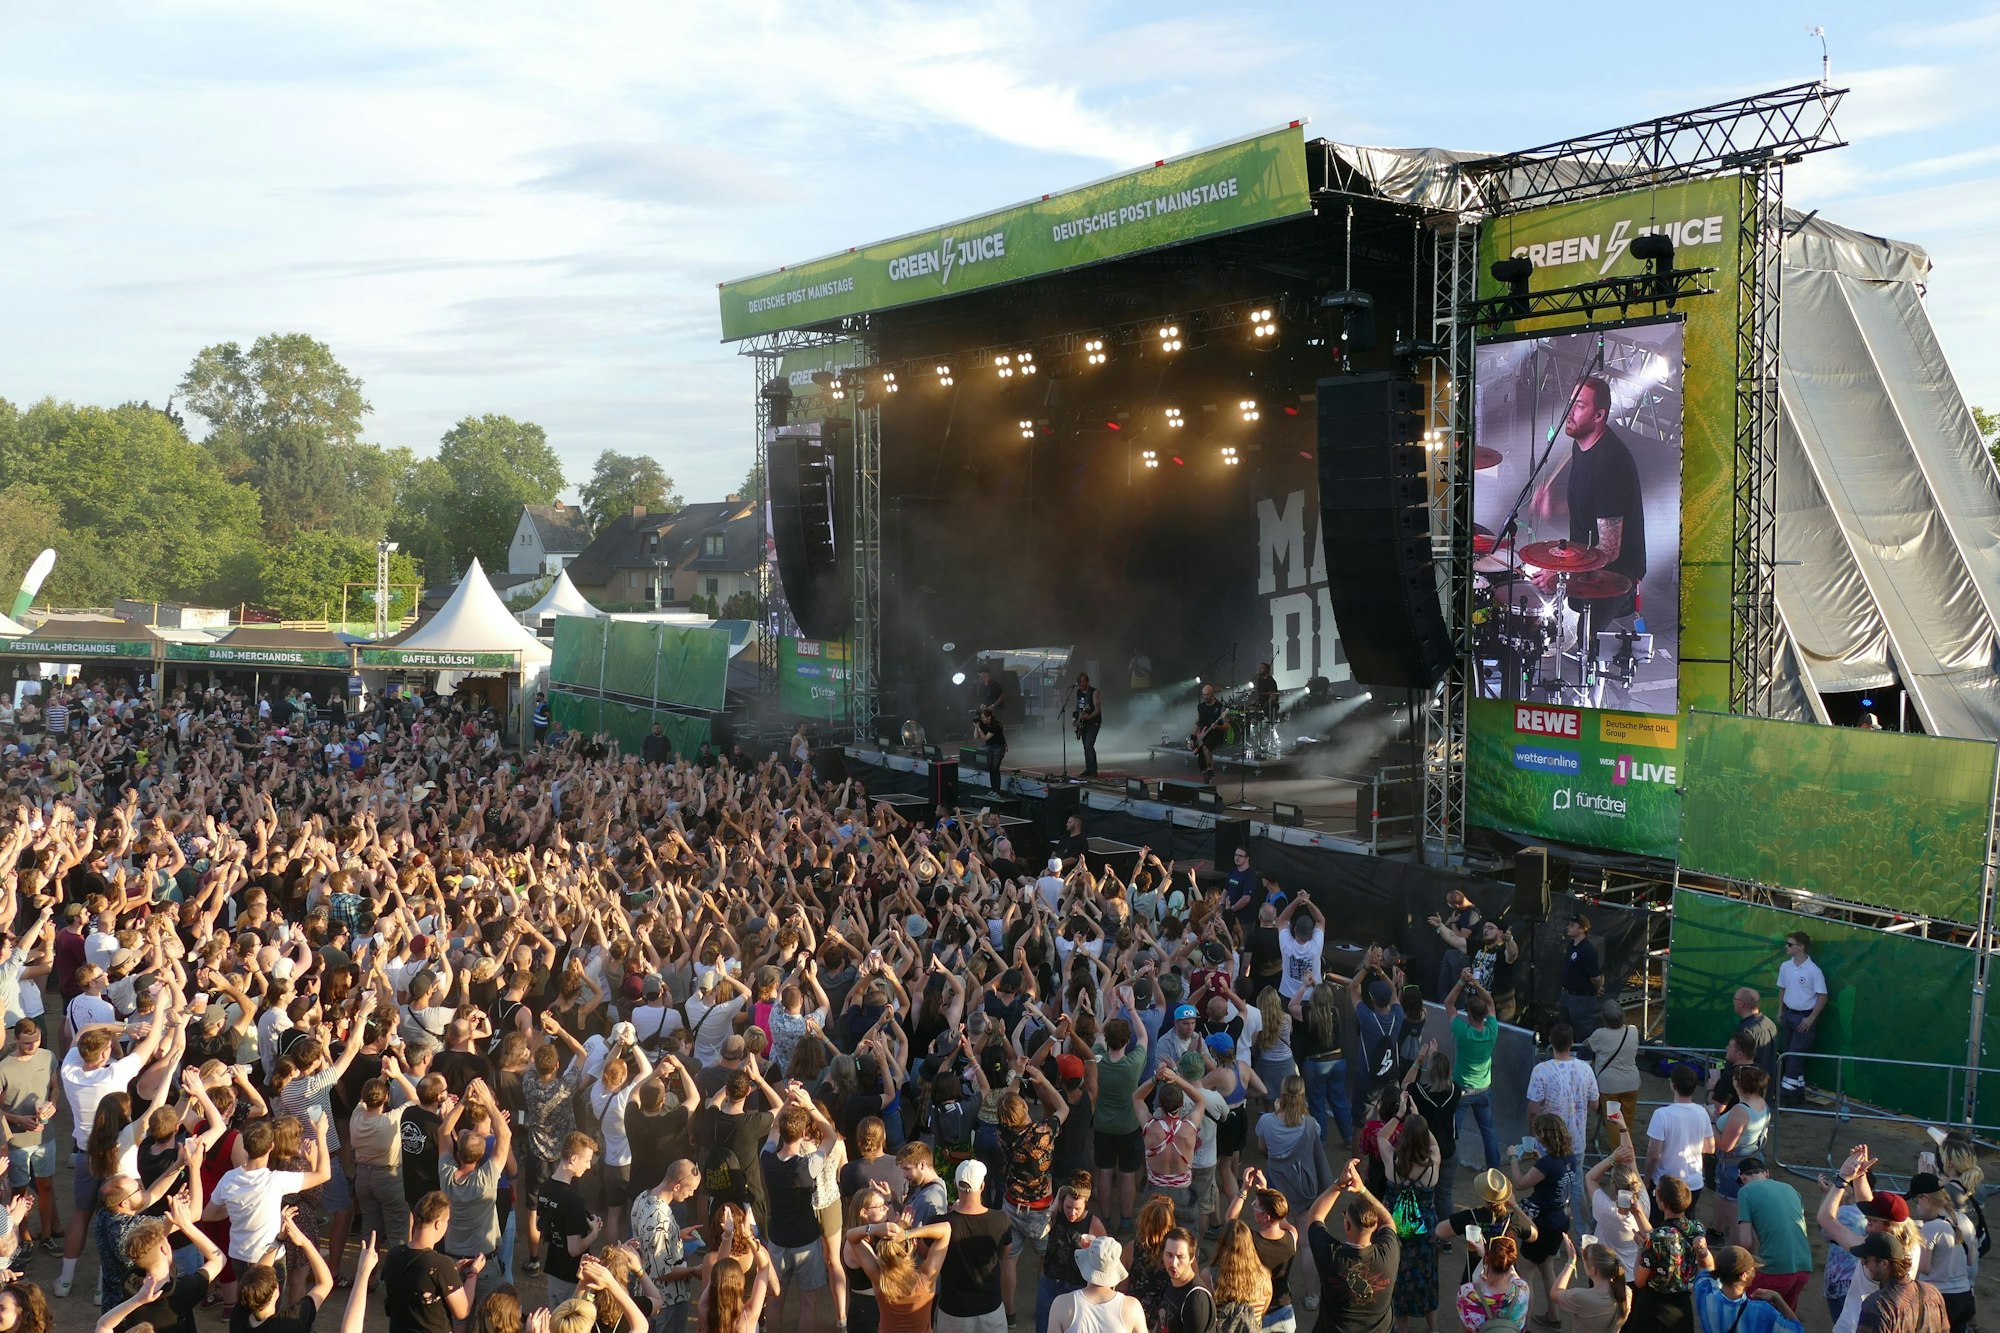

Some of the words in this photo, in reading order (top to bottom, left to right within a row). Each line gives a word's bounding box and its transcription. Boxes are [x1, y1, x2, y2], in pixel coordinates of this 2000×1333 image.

[1052, 209, 1117, 242] DEUTSCHE
[1119, 201, 1152, 225] POST
[1155, 178, 1238, 215] MAINSTAGE
[1637, 215, 1724, 249] ICE
[888, 250, 939, 281] GREEN
[957, 232, 1005, 265] JUICE
[748, 293, 786, 313] DEUTSCHE
[787, 289, 806, 305] POST
[807, 277, 854, 299] MAINSTAGE
[10, 642, 116, 653] FESTIVAL-MERCHANDISE
[797, 641, 819, 656] REWE
[402, 655, 437, 664] GAFFEL
[439, 653, 474, 665] KÖLSCH
[1516, 708, 1577, 735] REWE
[1606, 719, 1638, 730] Deutsche
[1638, 723, 1654, 732] Post
[1655, 725, 1671, 733] DHL
[1605, 729, 1626, 739] Group
[1516, 752, 1577, 769] wetteronline
[1599, 757, 1615, 766] WDR
[1618, 760, 1626, 779] 1
[1631, 761, 1677, 785] LIVE
[1575, 791, 1626, 813] fünfdrei
